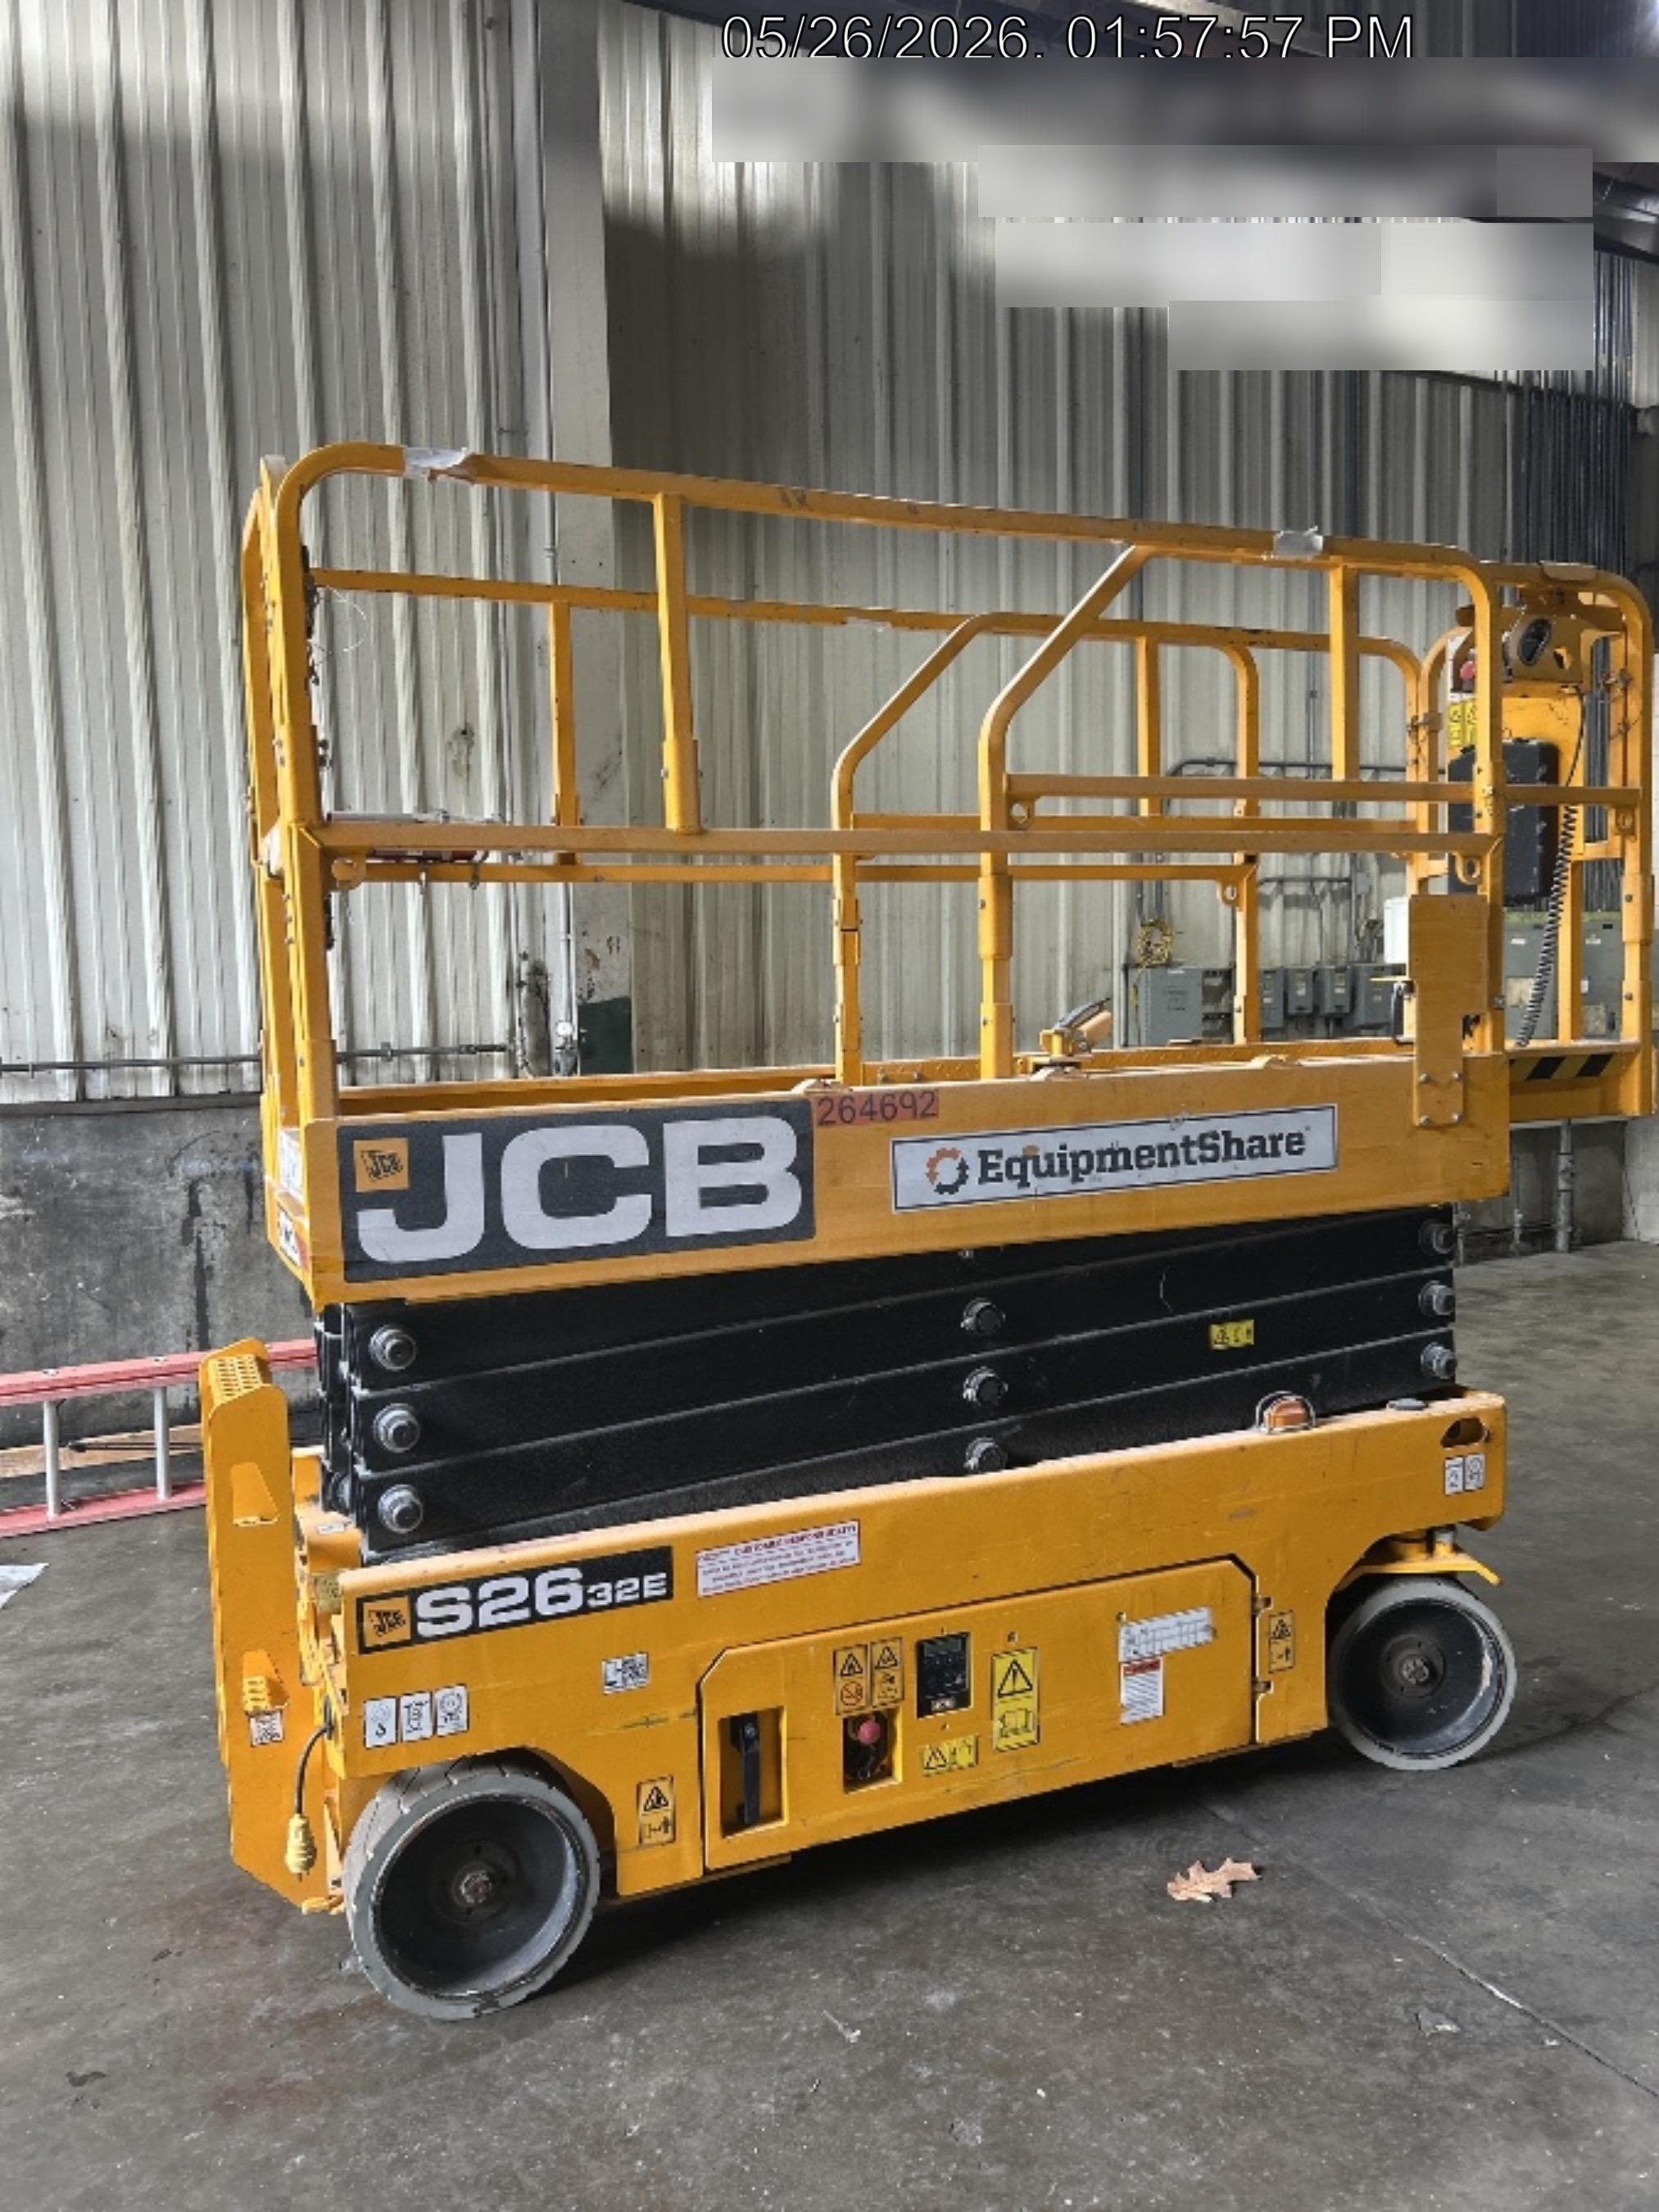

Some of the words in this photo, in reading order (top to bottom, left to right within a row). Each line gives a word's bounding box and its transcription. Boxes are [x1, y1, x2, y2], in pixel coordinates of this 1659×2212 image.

[818, 1090, 938, 1126] 264692
[977, 1129, 1307, 1188] EquipmentShare
[356, 1116, 802, 1263] JCB
